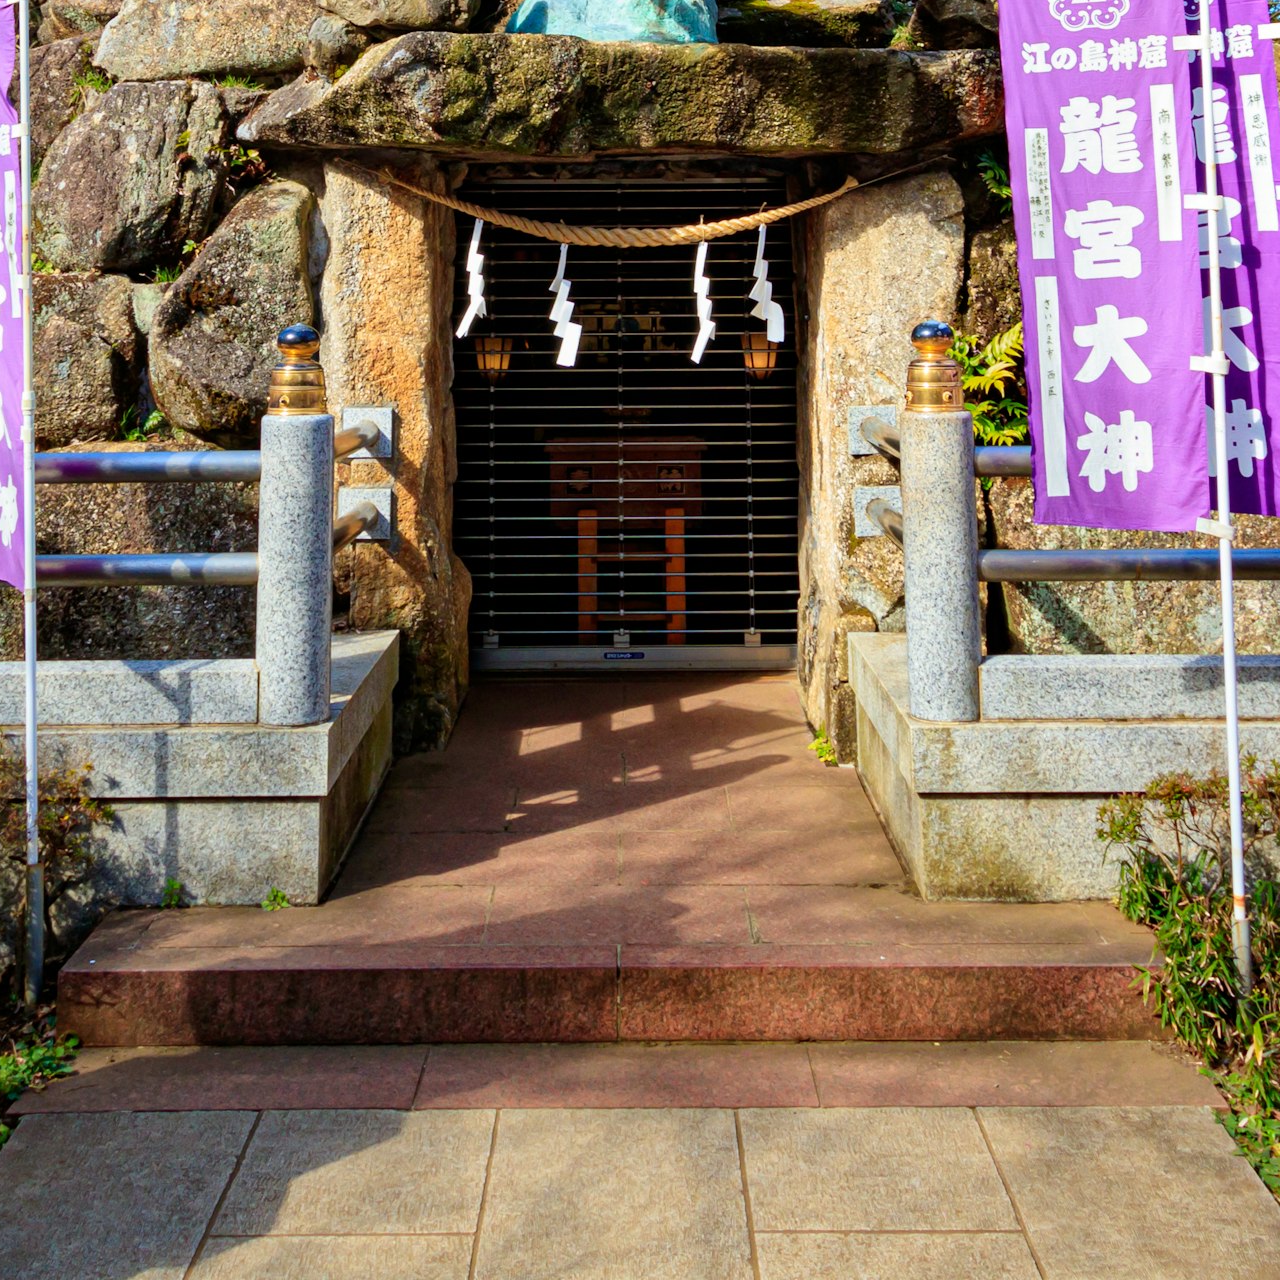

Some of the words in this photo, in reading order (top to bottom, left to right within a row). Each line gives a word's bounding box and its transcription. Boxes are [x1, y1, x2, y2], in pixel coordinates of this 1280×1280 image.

[1022, 35, 1167, 73] 江の島神窟
[1188, 25, 1253, 63] 神窟
[1247, 92, 1268, 167] 神恩感謝
[1059, 95, 1153, 492] 龍宮大神
